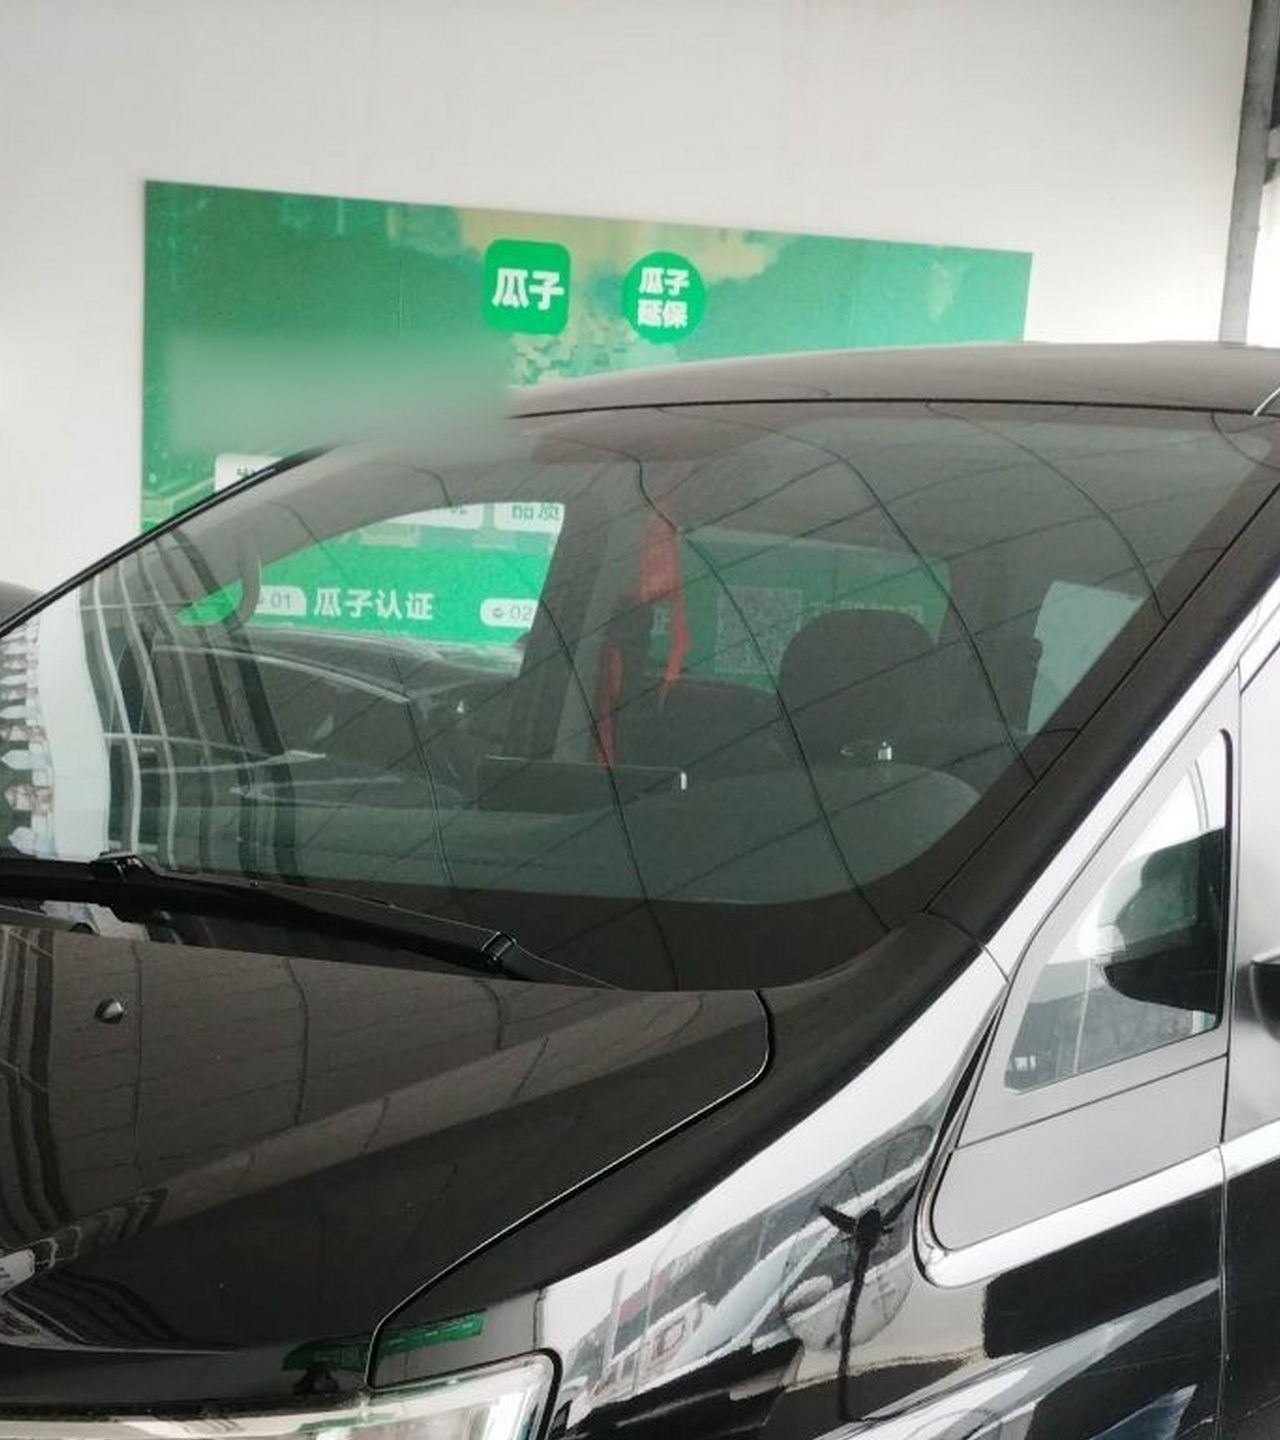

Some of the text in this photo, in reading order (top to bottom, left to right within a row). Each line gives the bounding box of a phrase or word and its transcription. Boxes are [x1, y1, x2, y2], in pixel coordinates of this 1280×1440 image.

[491, 266, 565, 311] 瓜子
[638, 266, 690, 296] 瓜子
[313, 587, 436, 621] 瓜子认证
